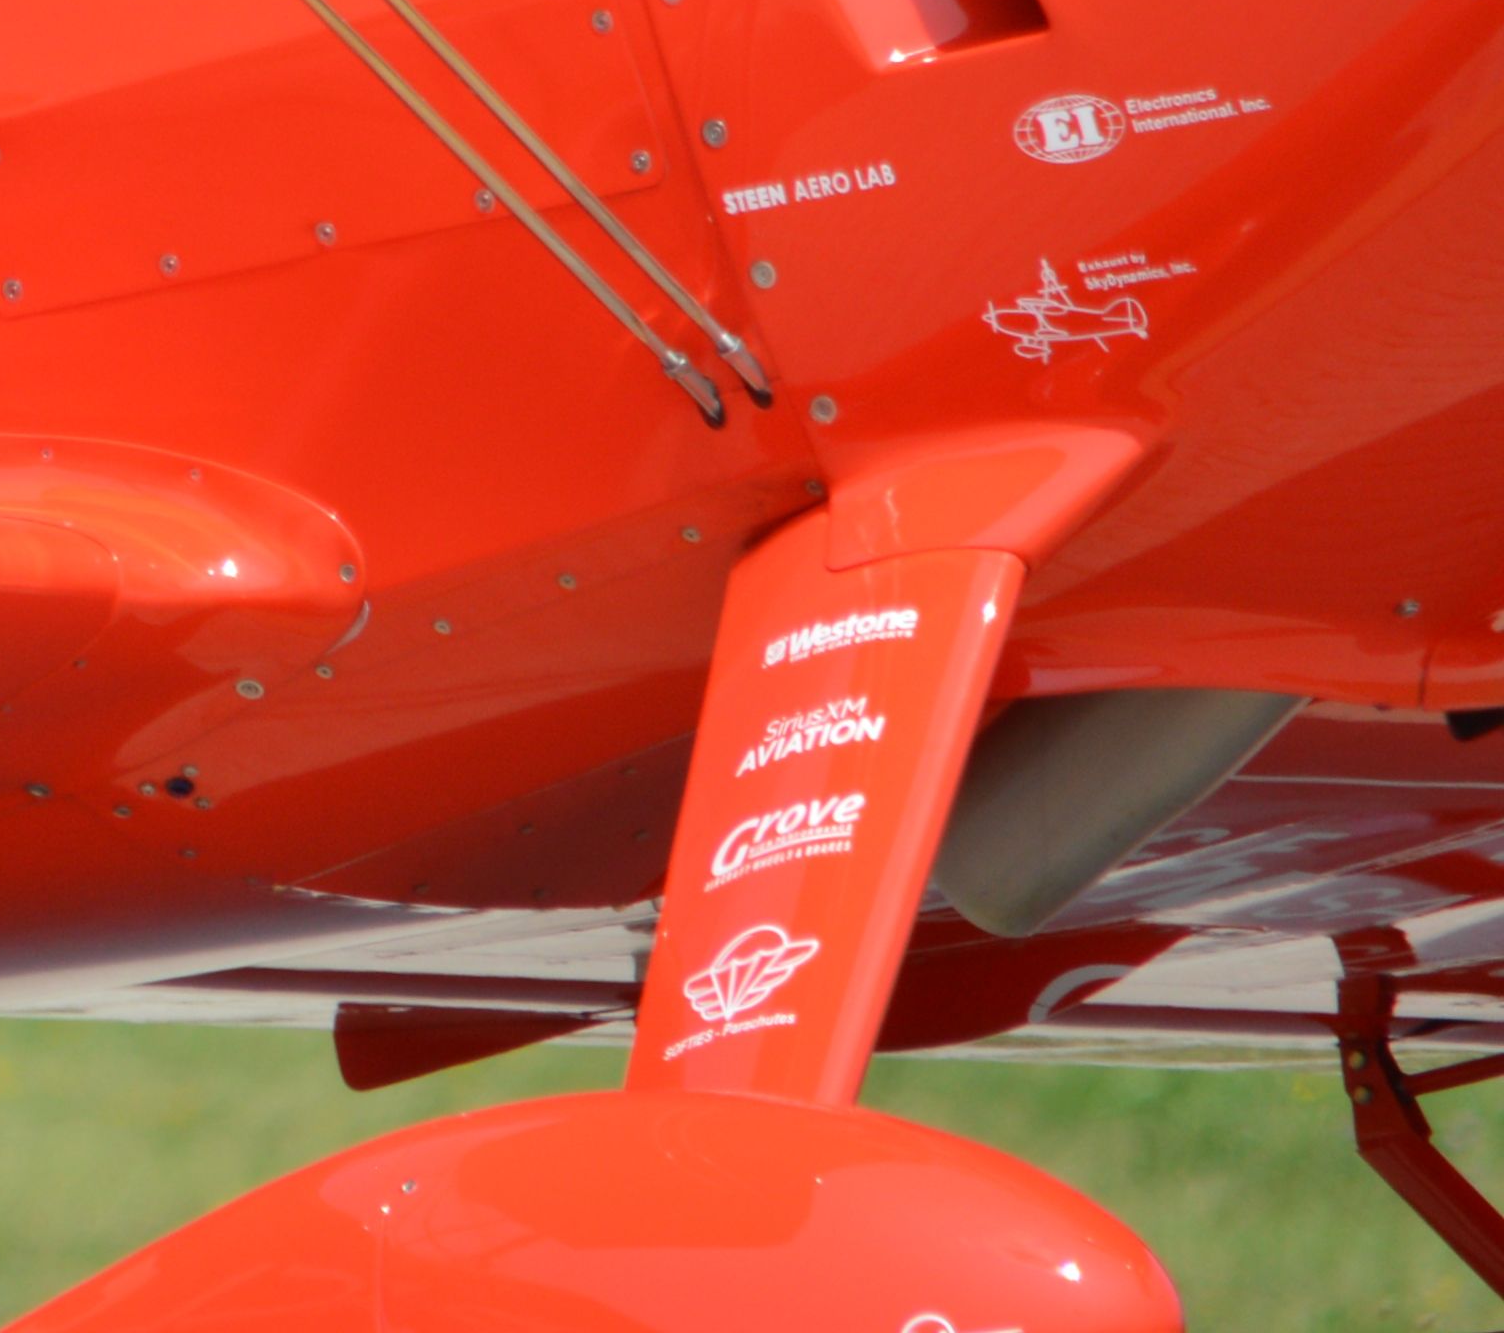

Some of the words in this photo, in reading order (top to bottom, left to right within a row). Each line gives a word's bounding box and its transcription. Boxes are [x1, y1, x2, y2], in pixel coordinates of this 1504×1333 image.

[1125, 87, 1217, 115] Electronics
[1239, 96, 1272, 115] Inc.
[1037, 105, 1105, 153] EI
[722, 182, 788, 215] STEEN
[794, 170, 852, 202] AERO
[855, 162, 896, 193] LAB
[1130, 252, 1146, 265] by
[789, 609, 919, 655] Westone
[764, 696, 867, 743] SiriusXM
[736, 715, 886, 777] AVIATION
[711, 793, 866, 877] Grove
